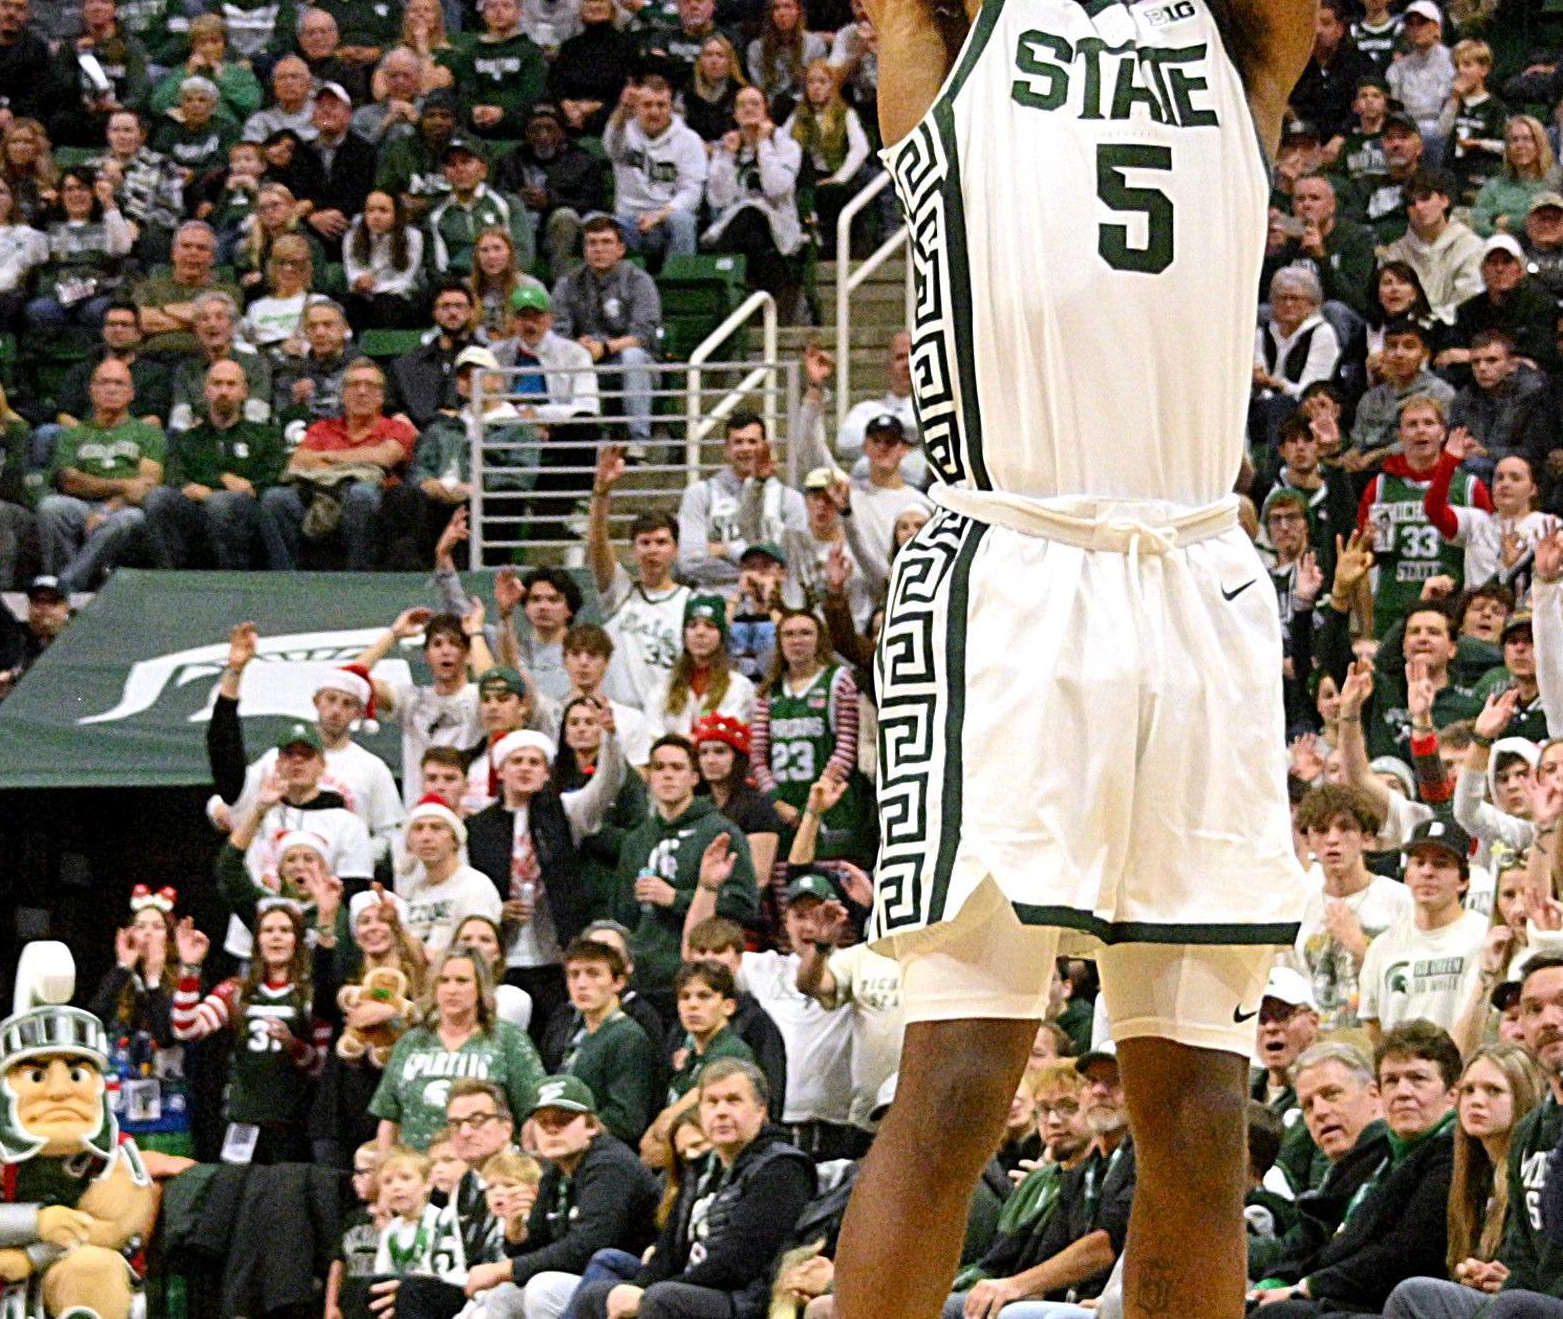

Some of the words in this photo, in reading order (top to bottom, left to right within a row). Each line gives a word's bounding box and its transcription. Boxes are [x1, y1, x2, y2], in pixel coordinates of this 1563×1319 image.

[1011, 29, 1220, 128] STATE
[1096, 143, 1174, 274] 5
[1400, 525, 1440, 558] 33
[771, 742, 814, 782] 23
